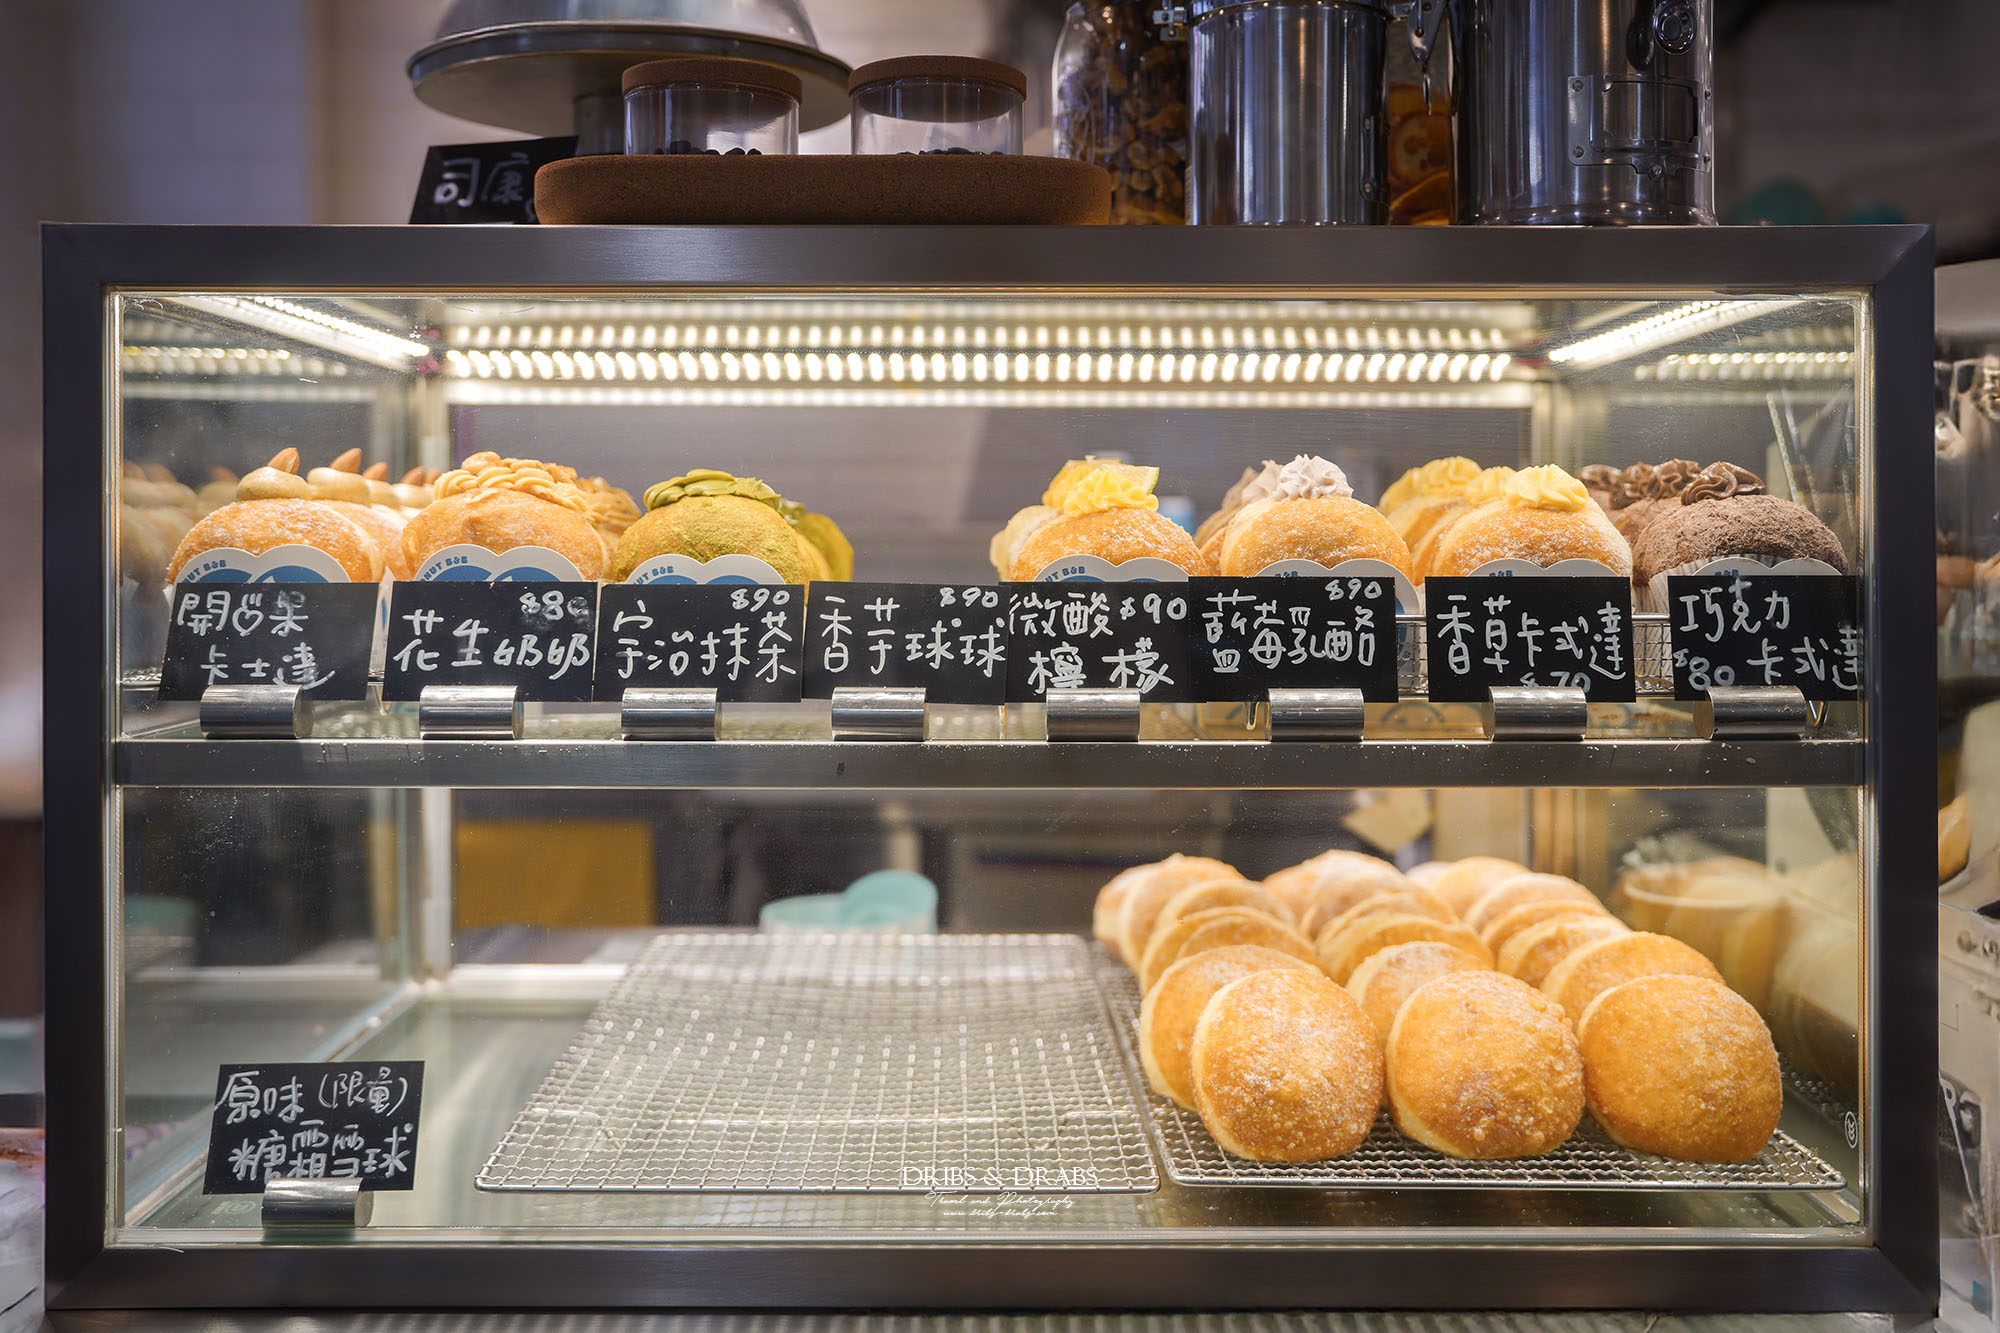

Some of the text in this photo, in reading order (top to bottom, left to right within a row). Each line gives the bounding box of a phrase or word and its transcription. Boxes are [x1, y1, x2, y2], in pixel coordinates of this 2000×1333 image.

[433, 151, 529, 207] 司康
[203, 560, 227, 571] B&B
[421, 556, 468, 581] NUT B&B
[652, 566, 674, 576] B&B
[1062, 566, 1086, 576] B&B
[1324, 578, 1383, 601] $90
[730, 588, 791, 611] $90
[939, 586, 999, 608] $90
[1009, 592, 1188, 639] 微酸 $90
[1678, 576, 1791, 643] 巧克力
[612, 599, 797, 682] 宇治抹茶
[819, 595, 1006, 678] 香芋球球
[1201, 588, 1376, 674] 藍莓乳酪
[1436, 594, 1627, 681] 香草卡式達
[200, 641, 336, 690] 卡士達
[1027, 637, 1175, 694] 檸檬
[1672, 648, 1736, 691] $80
[213, 1070, 305, 1125] 原味
[228, 1119, 414, 1184] 糖霜雪球
